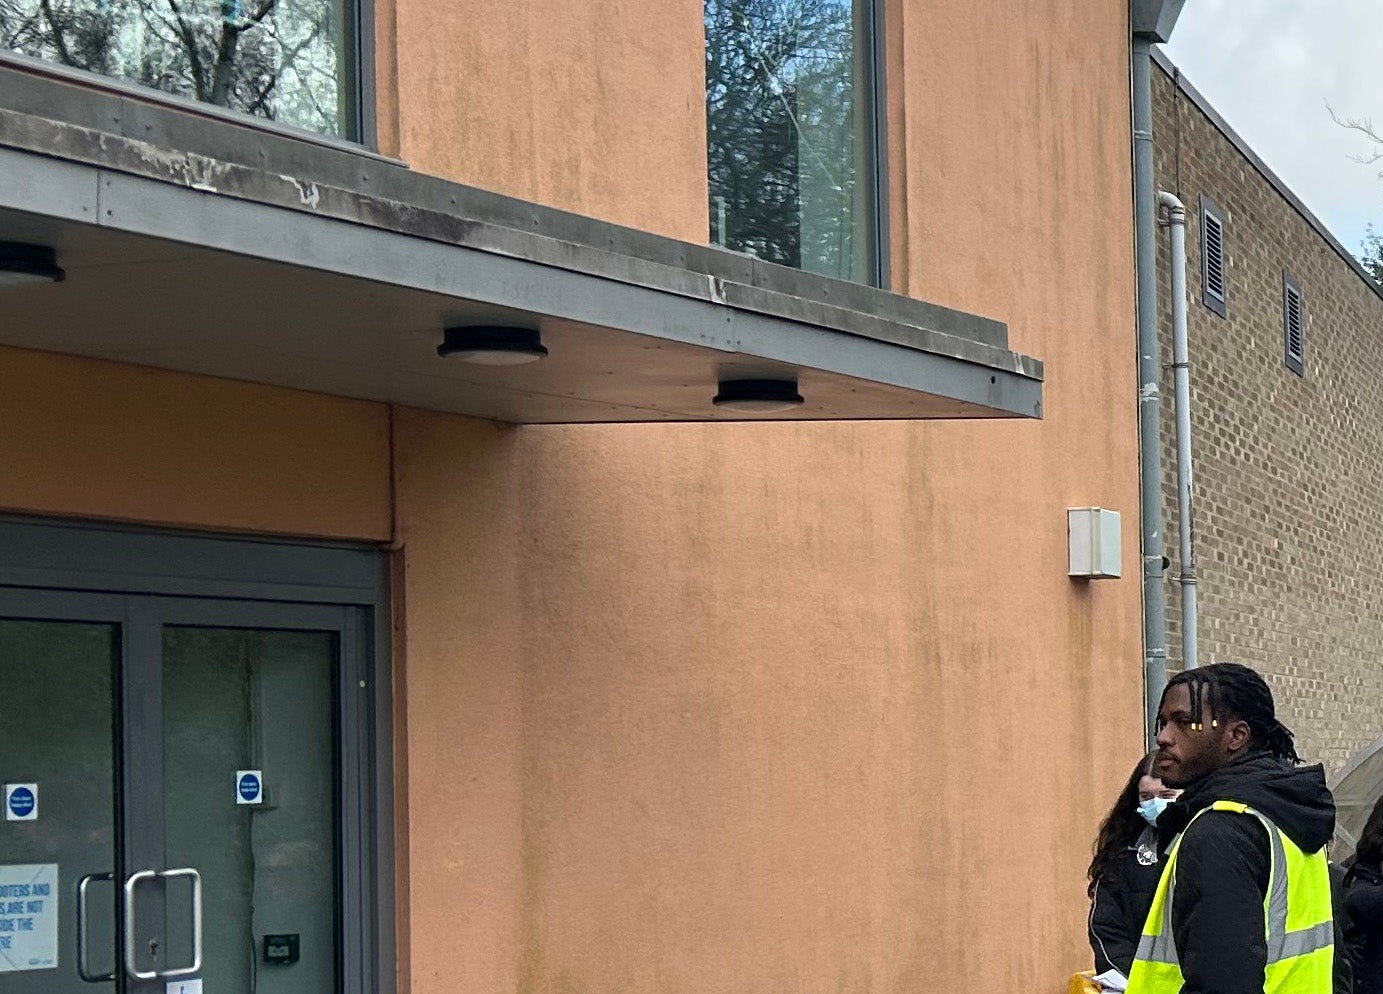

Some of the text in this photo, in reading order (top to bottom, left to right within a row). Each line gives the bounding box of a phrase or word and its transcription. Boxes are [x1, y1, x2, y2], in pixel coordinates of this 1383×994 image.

[32, 883, 50, 896] AND
[8, 901, 24, 914] ARE
[26, 900, 43, 913] NOT
[17, 917, 33, 931] THE
